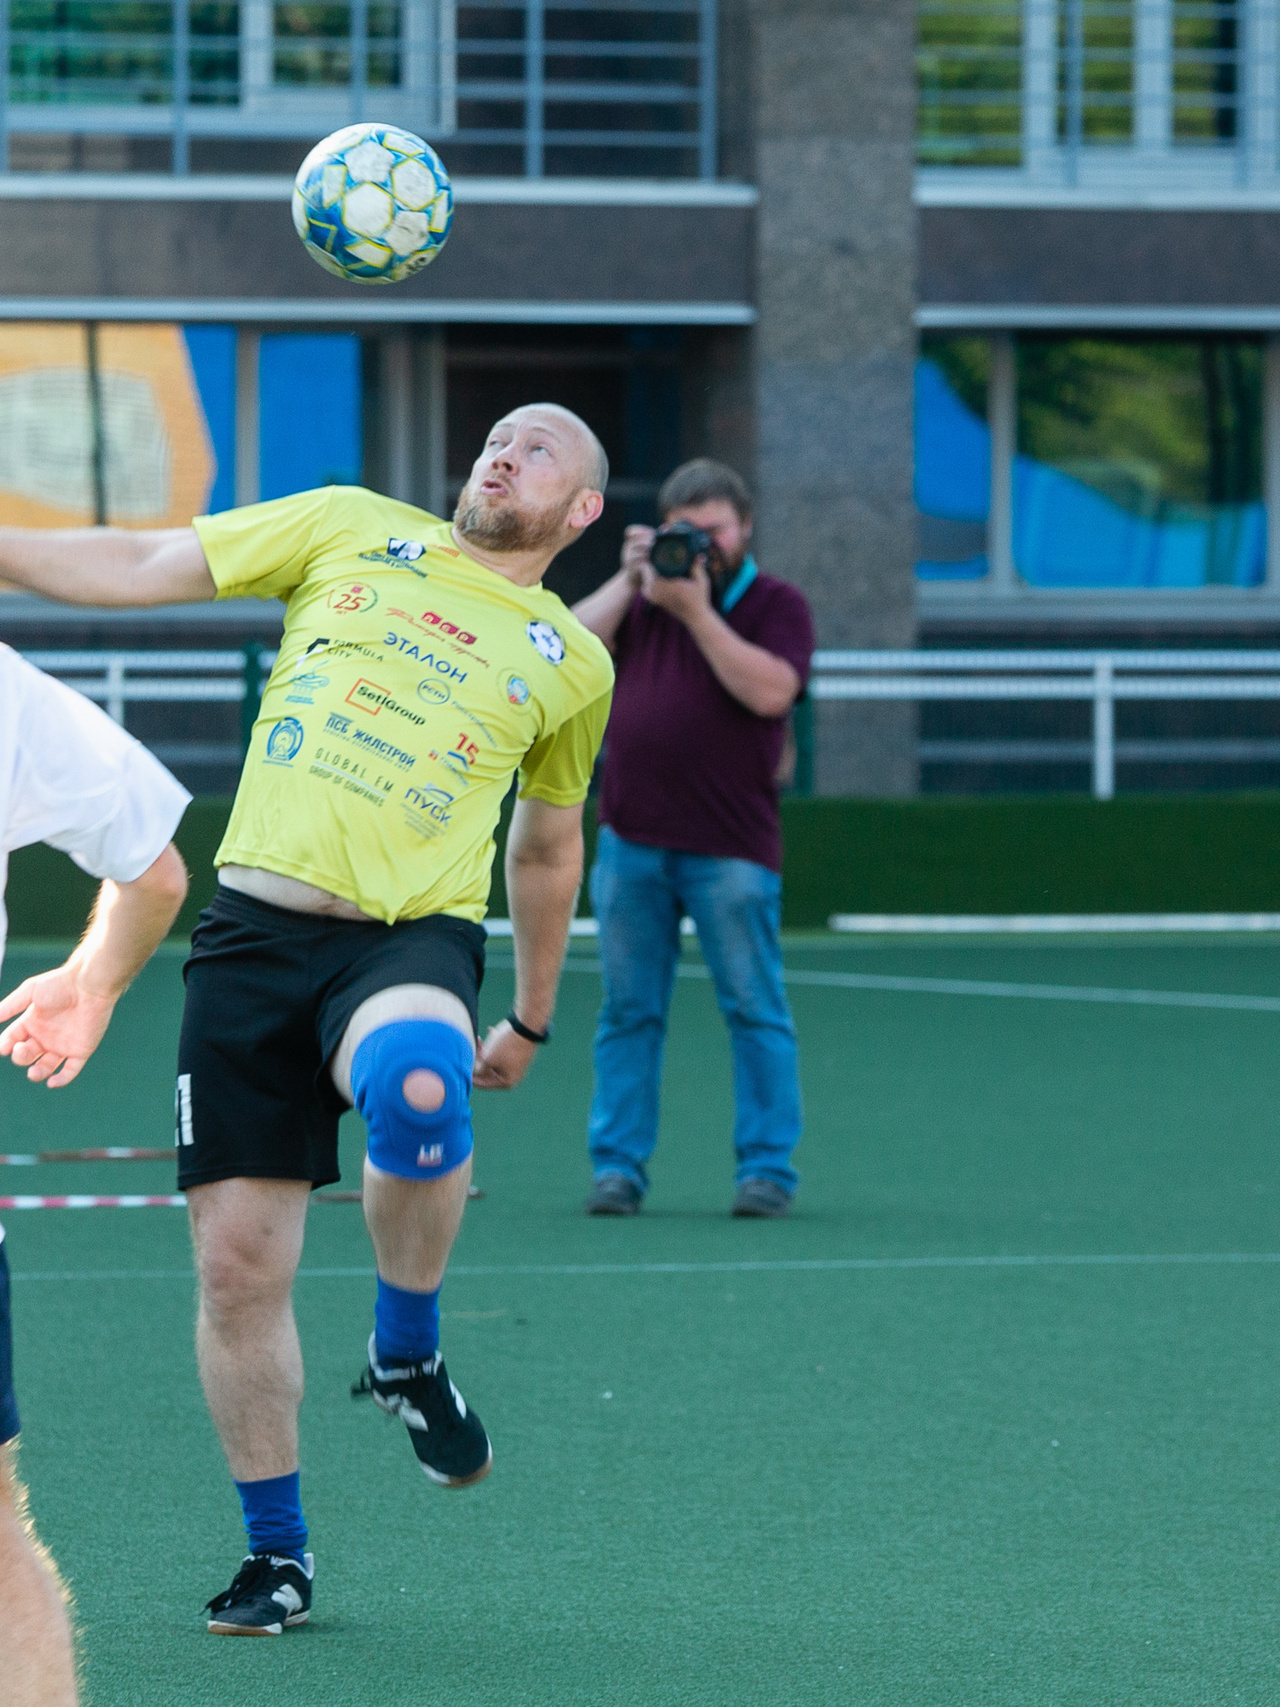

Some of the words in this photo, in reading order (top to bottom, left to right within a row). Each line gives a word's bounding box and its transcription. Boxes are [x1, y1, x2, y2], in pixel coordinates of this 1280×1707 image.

[333, 594, 368, 611] 25
[328, 647, 352, 659] CITY
[383, 631, 468, 683] ЭТАЛОН
[325, 715, 349, 734] ПСБ
[352, 728, 417, 768] ЖИЛСТРОЙ
[455, 732, 479, 765] 15
[315, 747, 368, 779] GLOBAL
[374, 776, 395, 793] EM
[404, 788, 452, 827] ПУСК
[175, 1073, 194, 1147] 1
